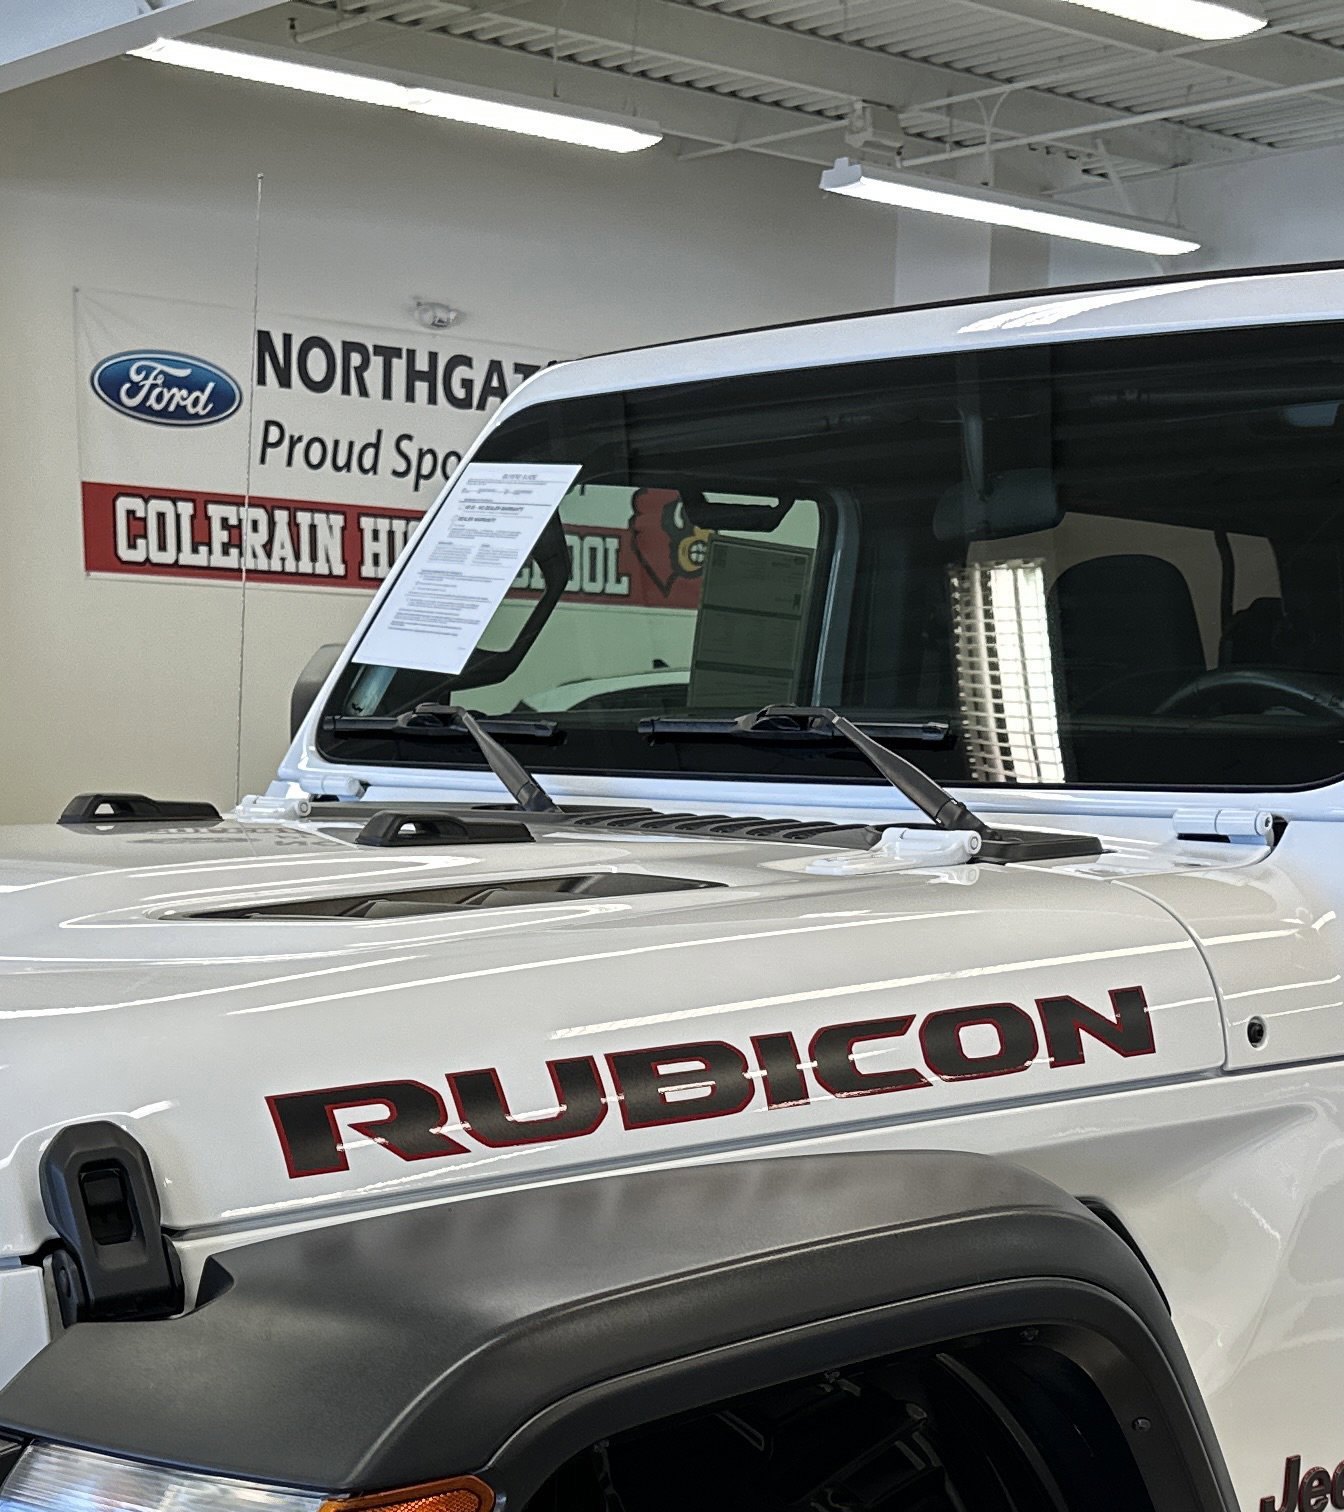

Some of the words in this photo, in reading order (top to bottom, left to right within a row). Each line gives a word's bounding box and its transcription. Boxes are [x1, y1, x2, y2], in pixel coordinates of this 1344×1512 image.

[119, 360, 216, 416] Ford
[259, 419, 383, 477] Proud
[114, 494, 347, 578] COLERAIN
[358, 515, 421, 579] HI
[265, 985, 1158, 1179] RUBICON
